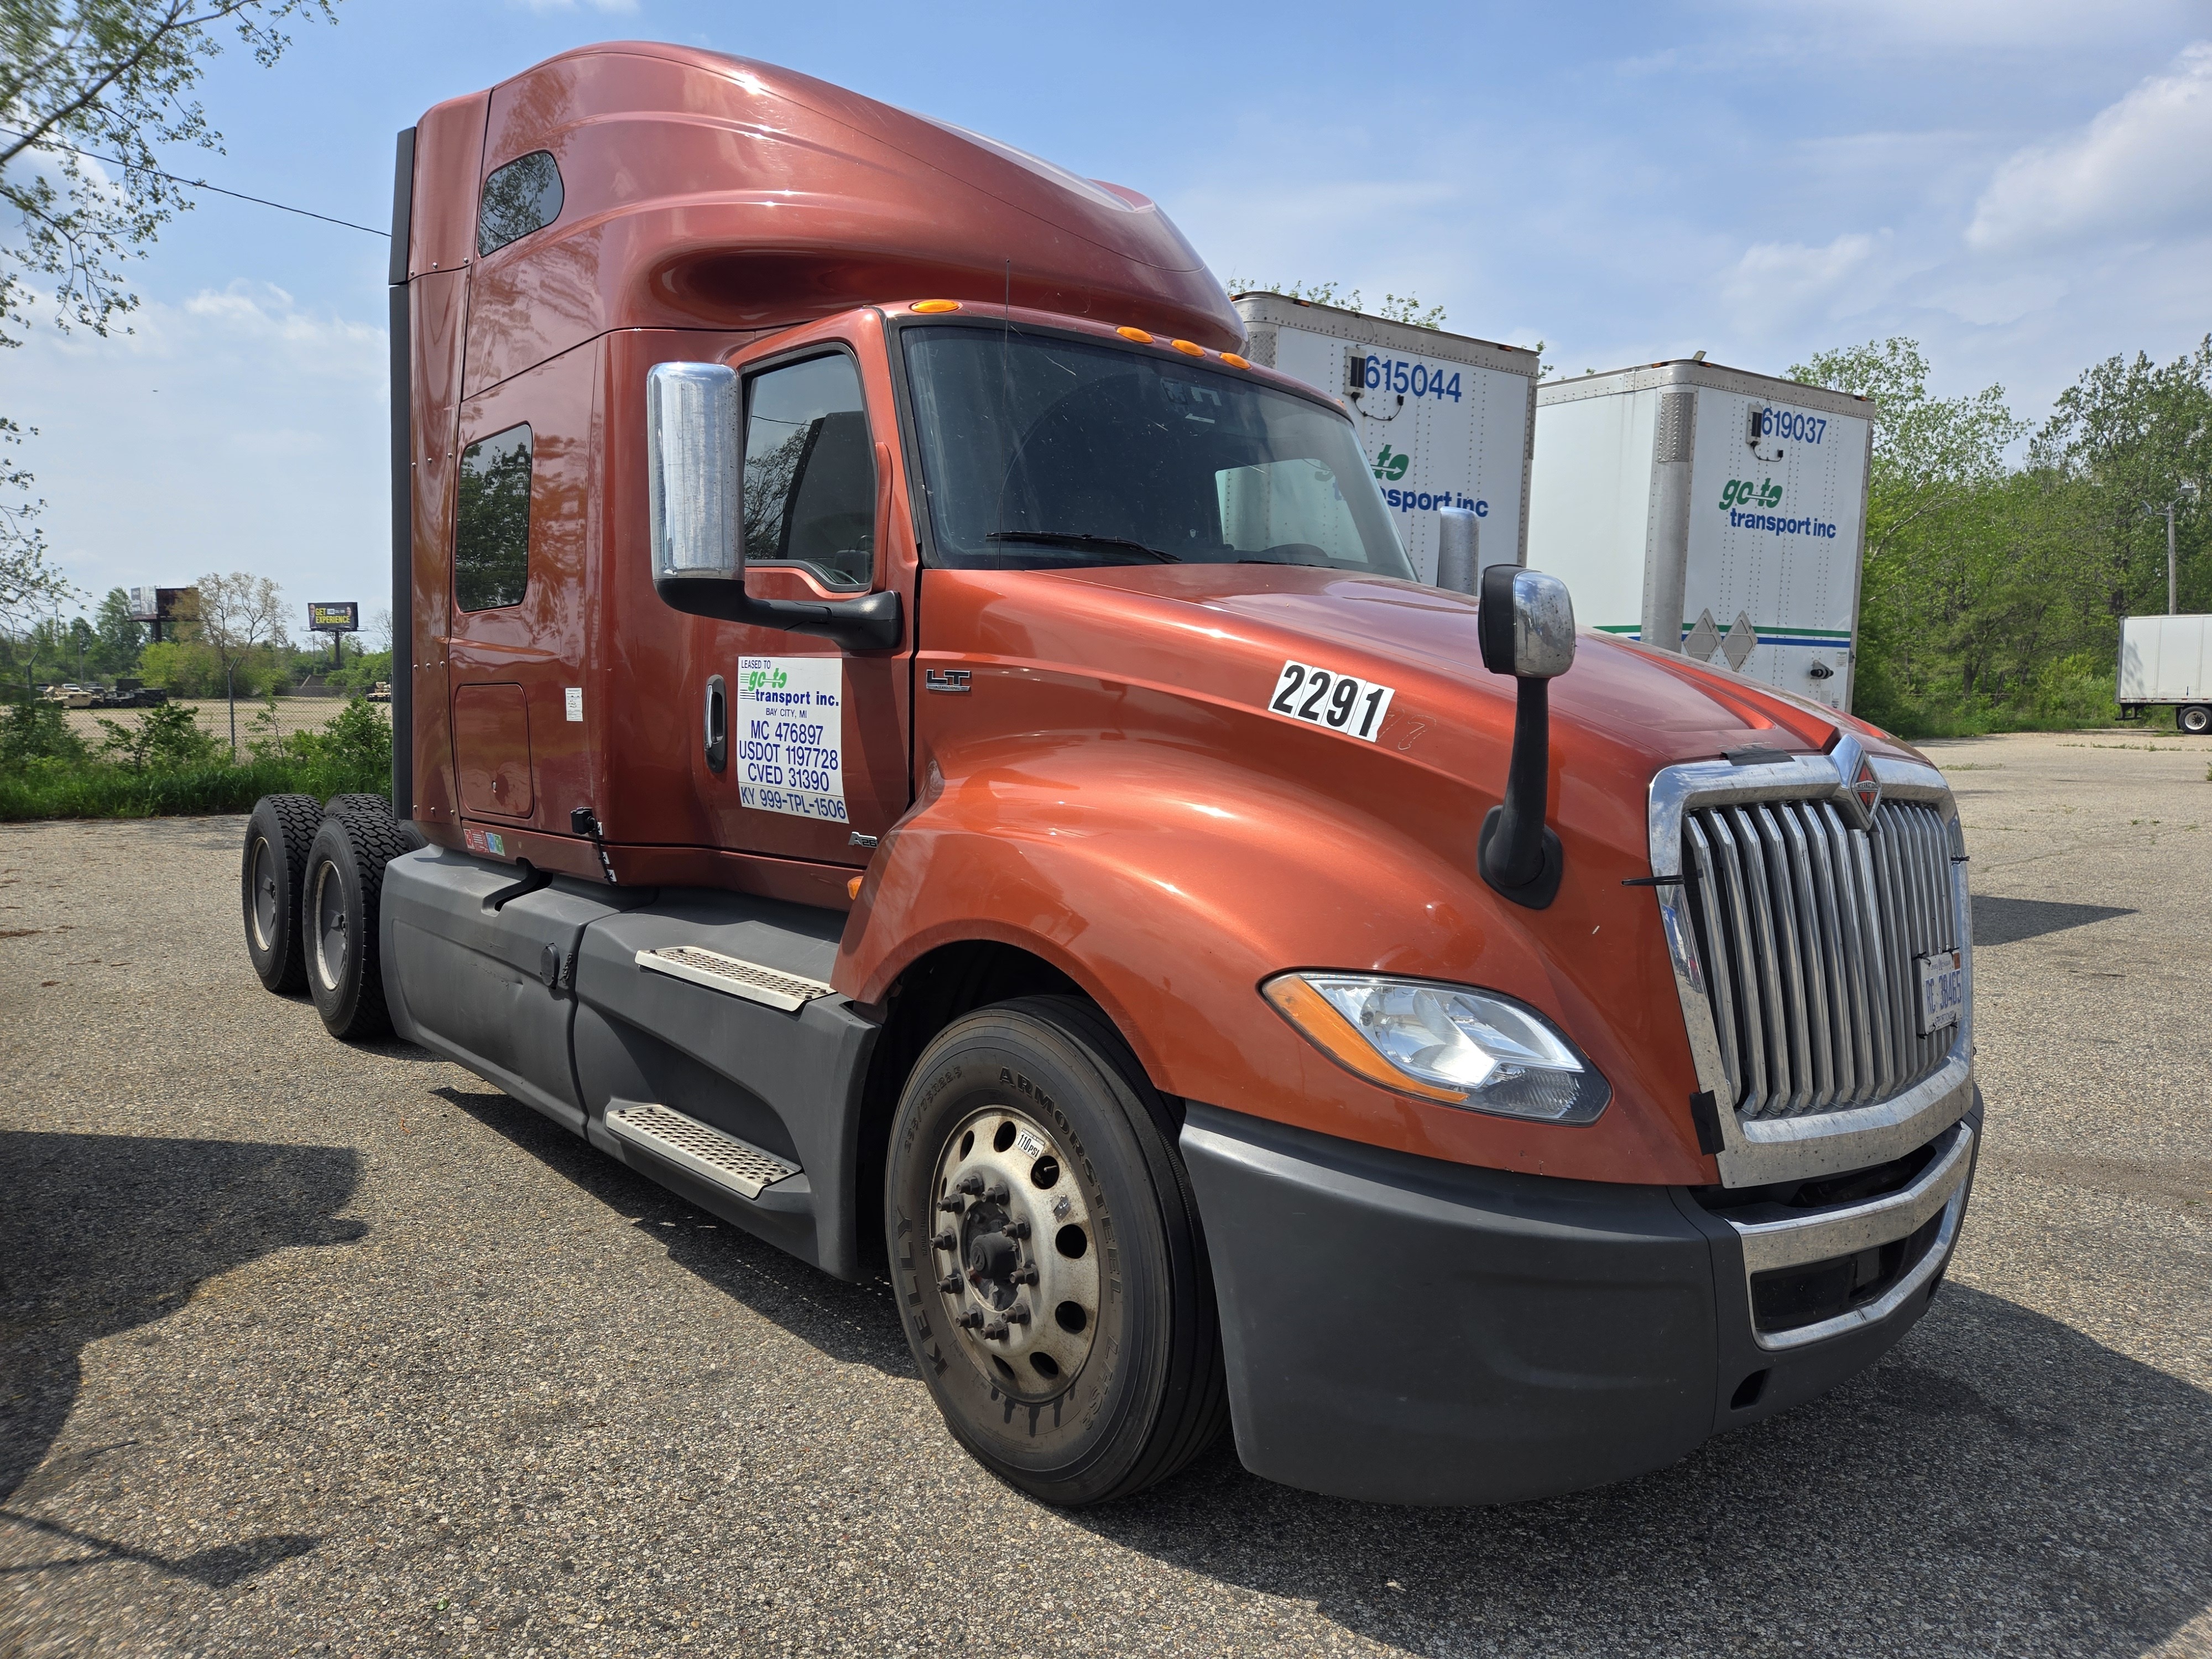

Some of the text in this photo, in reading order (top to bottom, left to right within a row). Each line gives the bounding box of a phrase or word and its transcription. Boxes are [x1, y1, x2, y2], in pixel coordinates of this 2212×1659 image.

[1365, 355, 1462, 403] 615044
[1762, 408, 1827, 444] 619037
[1730, 508, 1836, 538] transport inc
[315, 615, 351, 624] EXPERIENCE
[741, 660, 771, 669] LEASED TO
[926, 669, 971, 685] LT
[755, 688, 839, 706] transport inc.
[1272, 665, 1384, 737] 2291
[780, 708, 797, 718] CITY,
[751, 719, 823, 745] MC 476897
[739, 740, 838, 770] USDOT 1197728
[748, 763, 830, 792] CVED 31390
[740, 786, 846, 820] KY 999-TPL-1506
[848, 831, 878, 848] A26
[897, 1204, 949, 1379] KELLY
